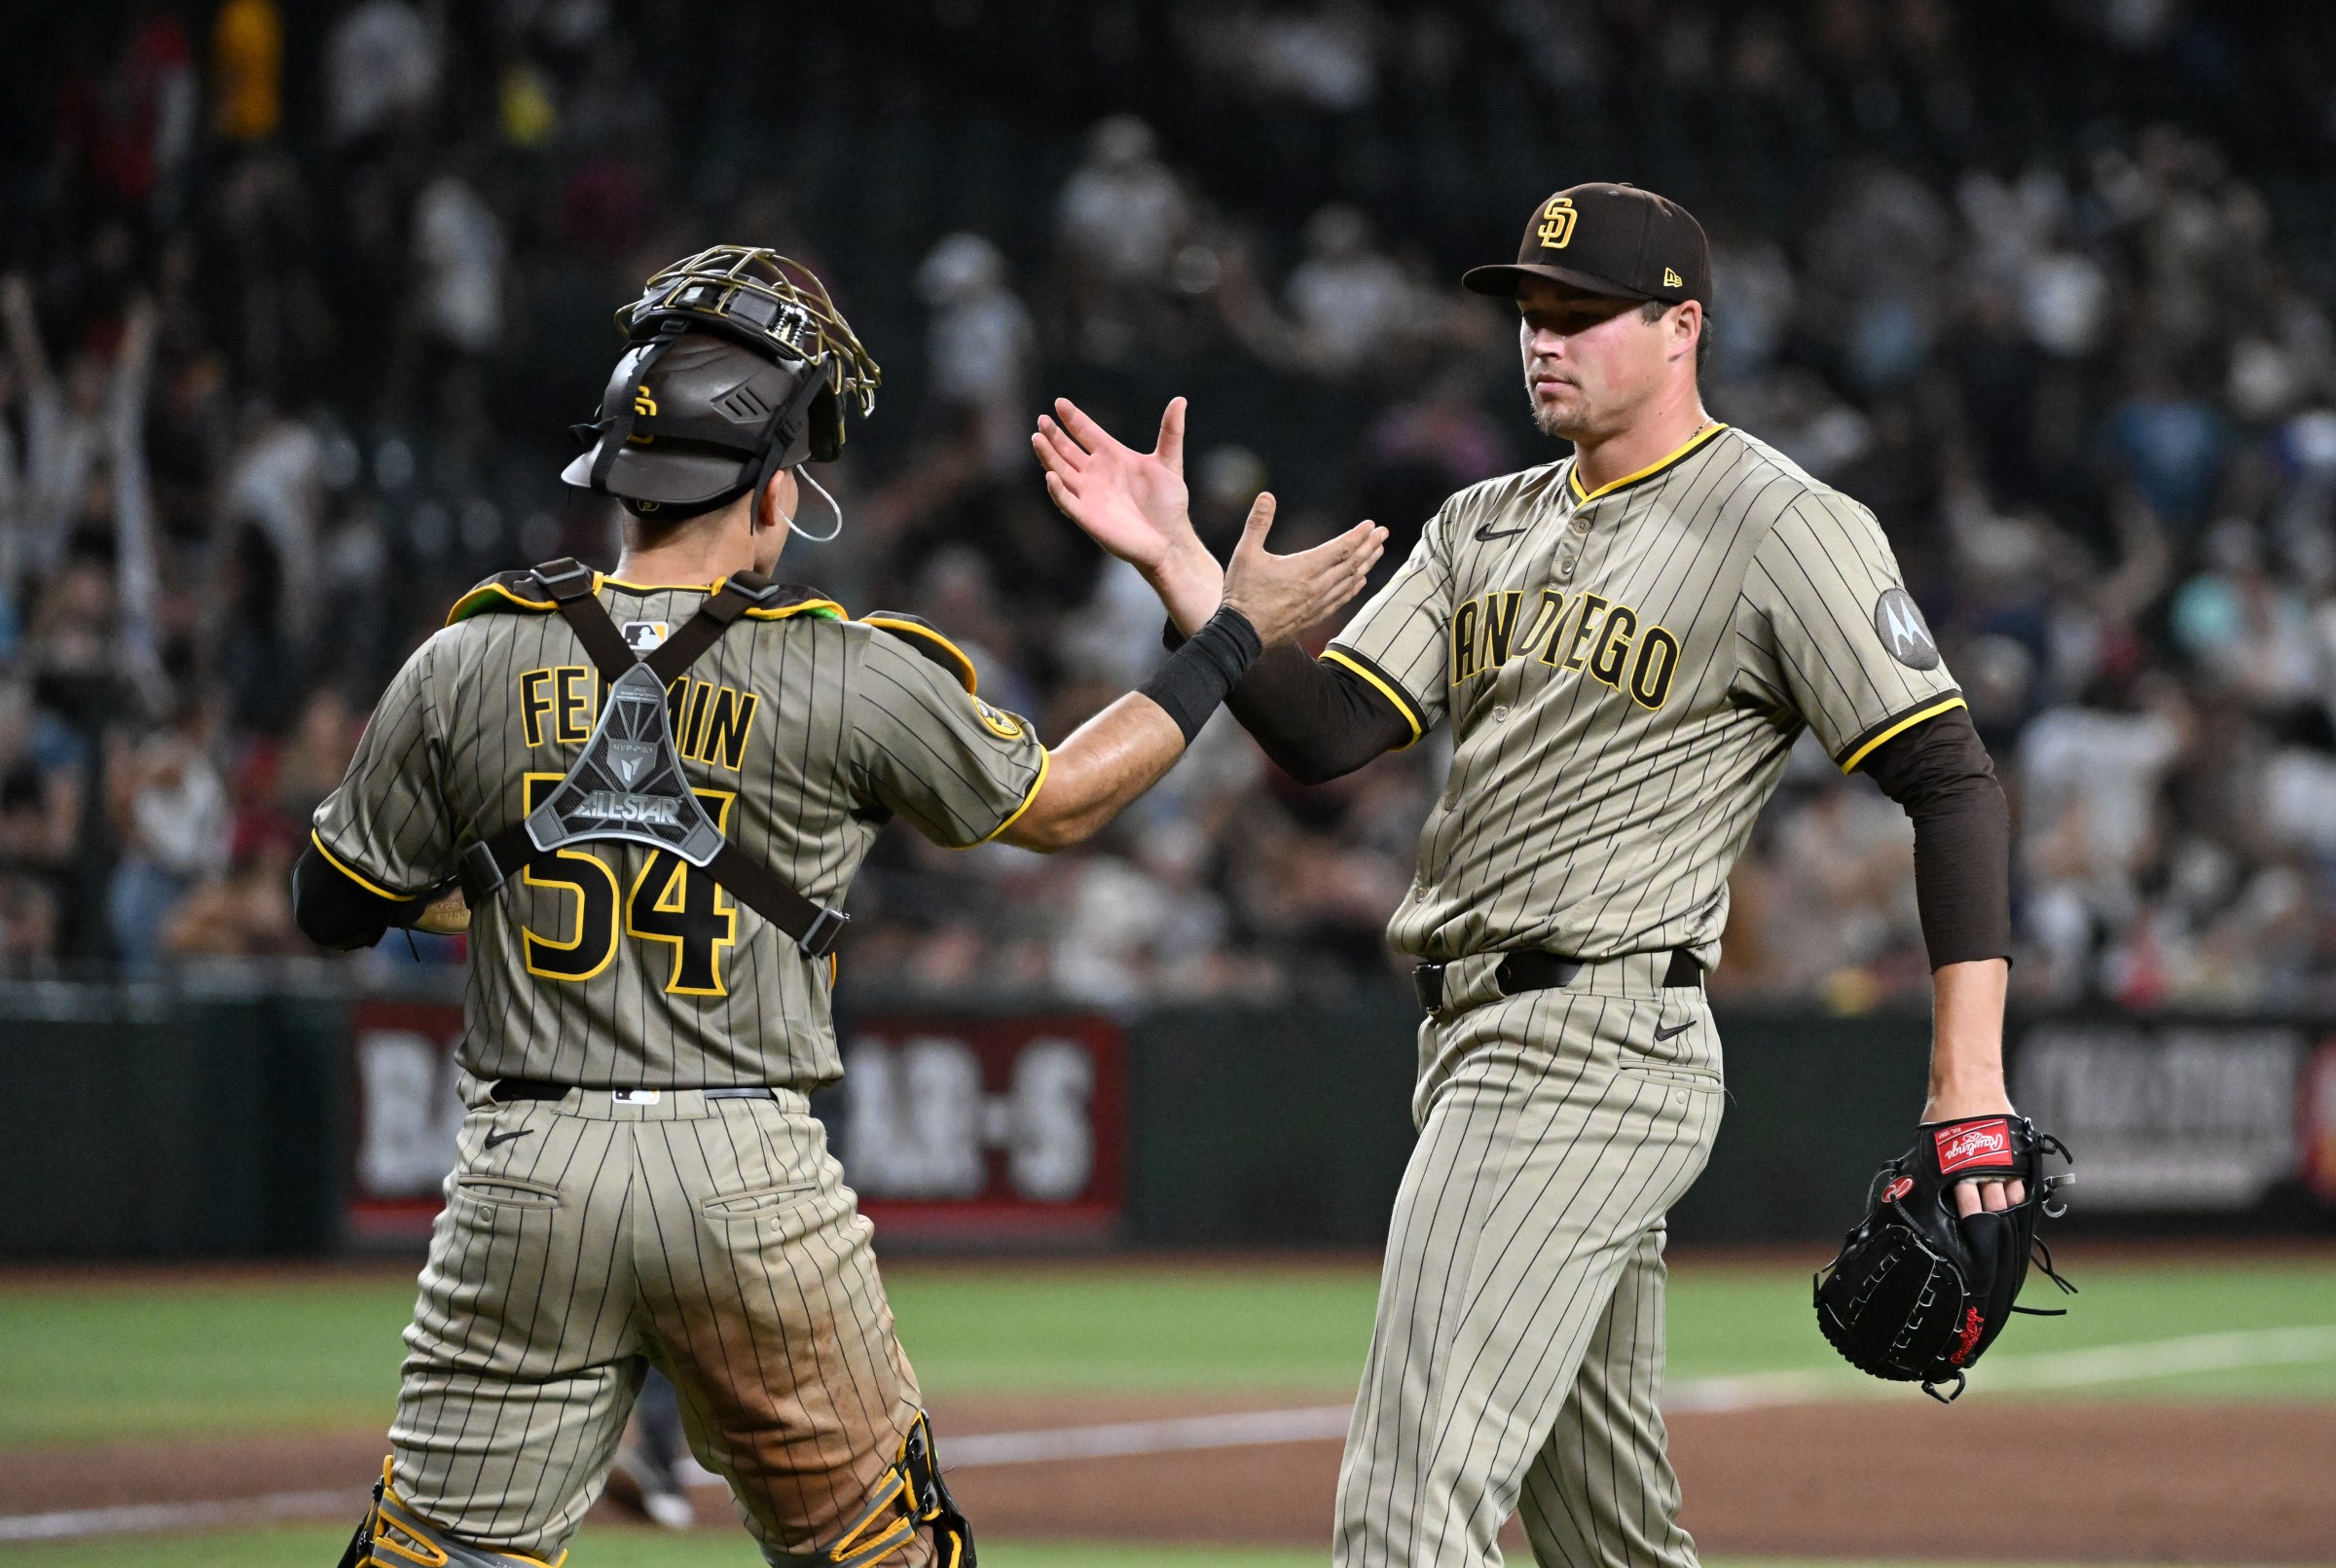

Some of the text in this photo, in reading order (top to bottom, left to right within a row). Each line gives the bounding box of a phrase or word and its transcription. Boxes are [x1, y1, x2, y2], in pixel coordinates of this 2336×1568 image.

[1511, 588, 1680, 711] DIEGO
[572, 791, 679, 824] ALL-STAR
[522, 772, 737, 997] 54
[1945, 1133, 2004, 1159] Rawlings
